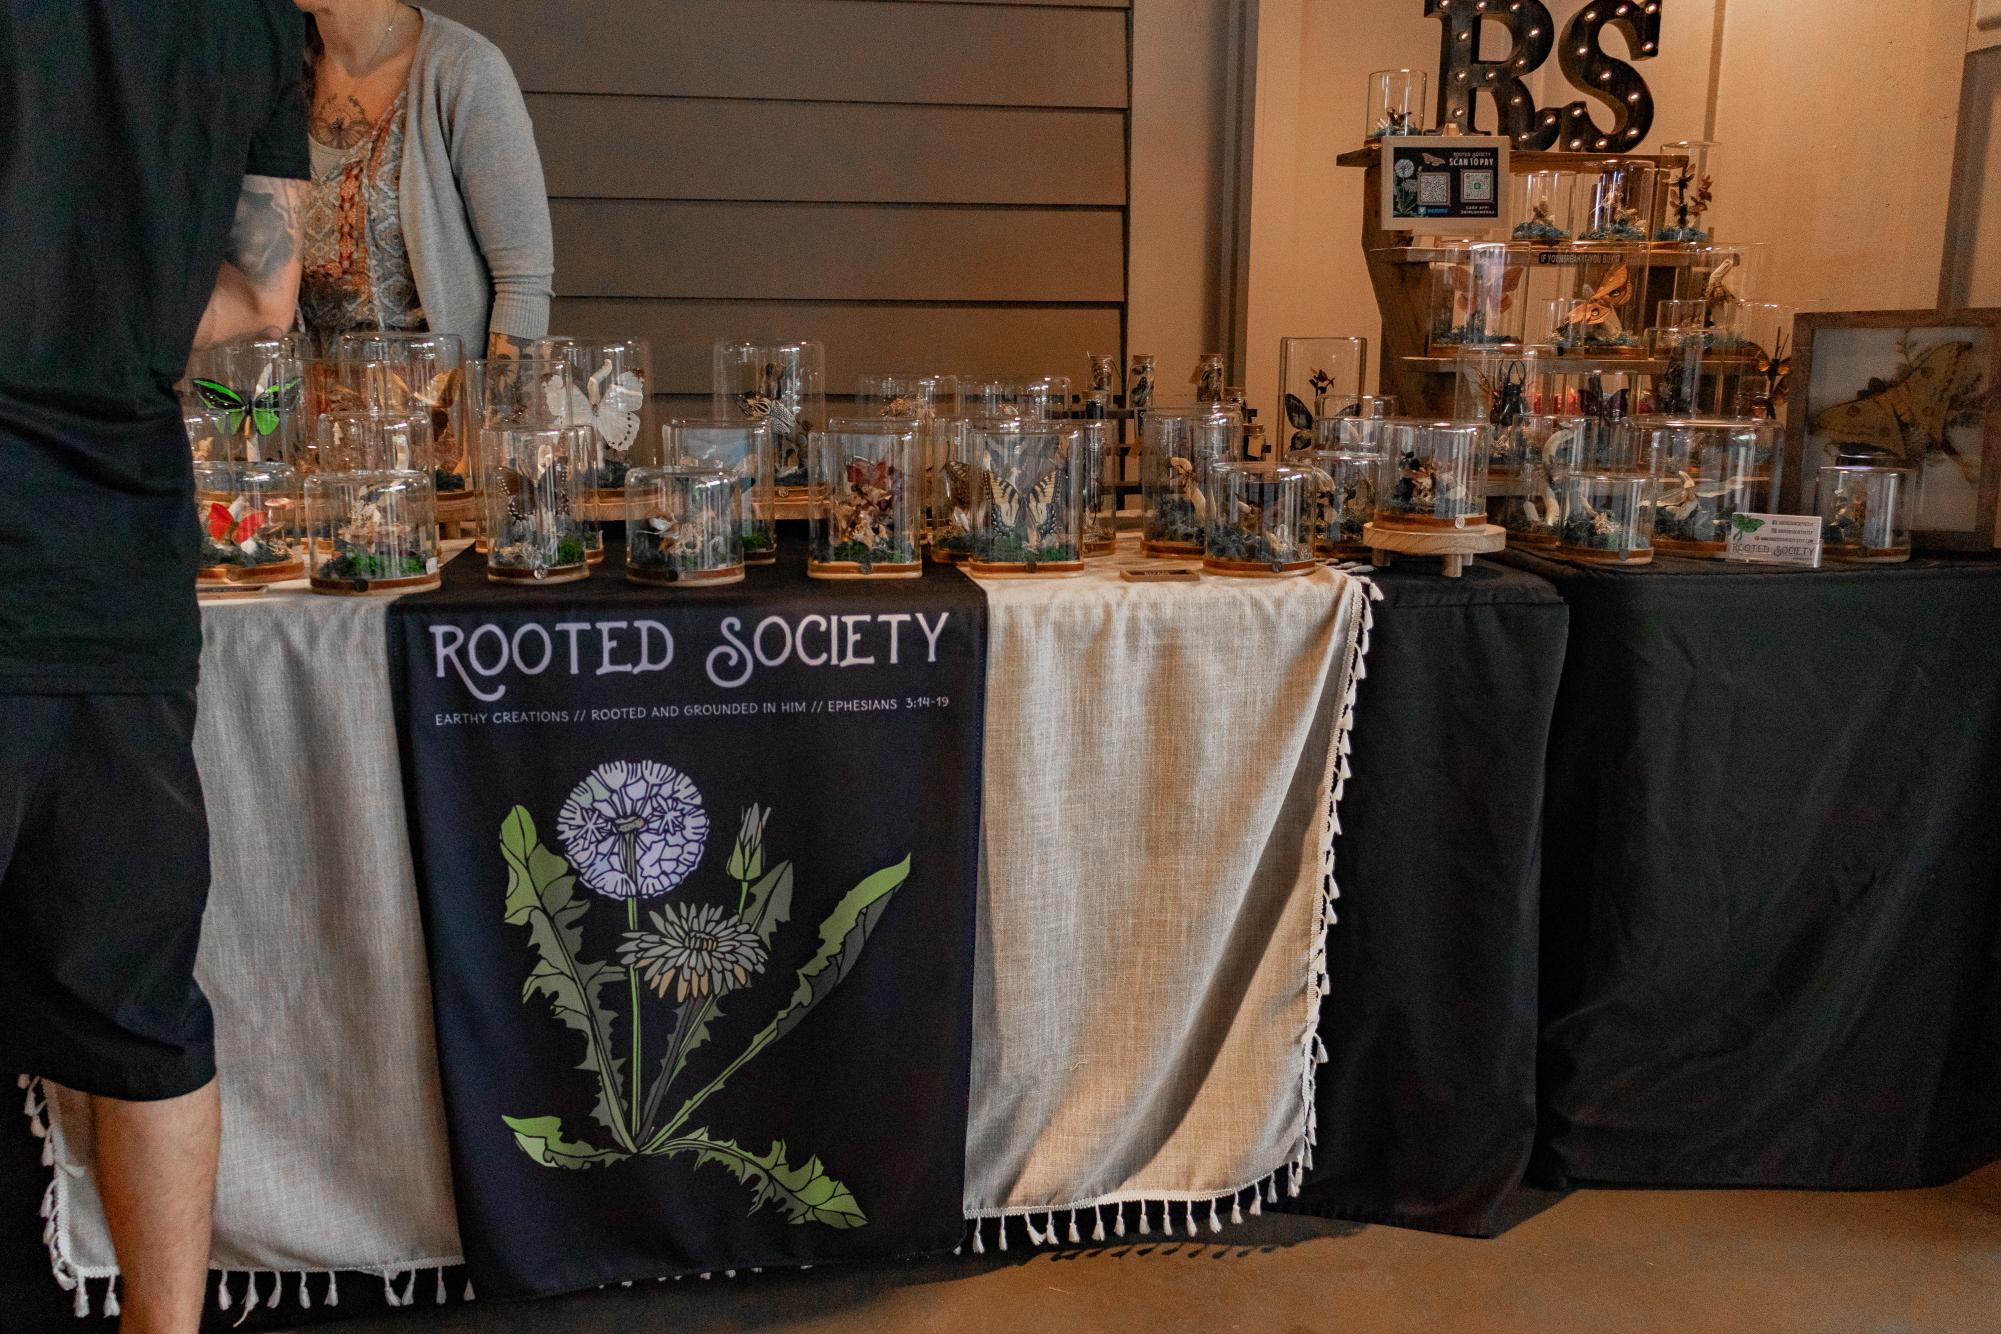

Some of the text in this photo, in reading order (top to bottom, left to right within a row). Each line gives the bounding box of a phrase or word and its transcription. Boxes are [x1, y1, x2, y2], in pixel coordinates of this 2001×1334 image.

[1424, 0, 1662, 152] RS
[1449, 157, 1494, 166] SCAN TO PAY
[1540, 254, 1547, 263] IF
[1732, 543, 1815, 557] ROOTED SOCIETY
[428, 611, 949, 702] ROOTED SOCIETY
[435, 696, 949, 726] EARTHY CREATIONS // ROOTED AND GROUNDED IN HIM // EPHESIANS 3:14-19
